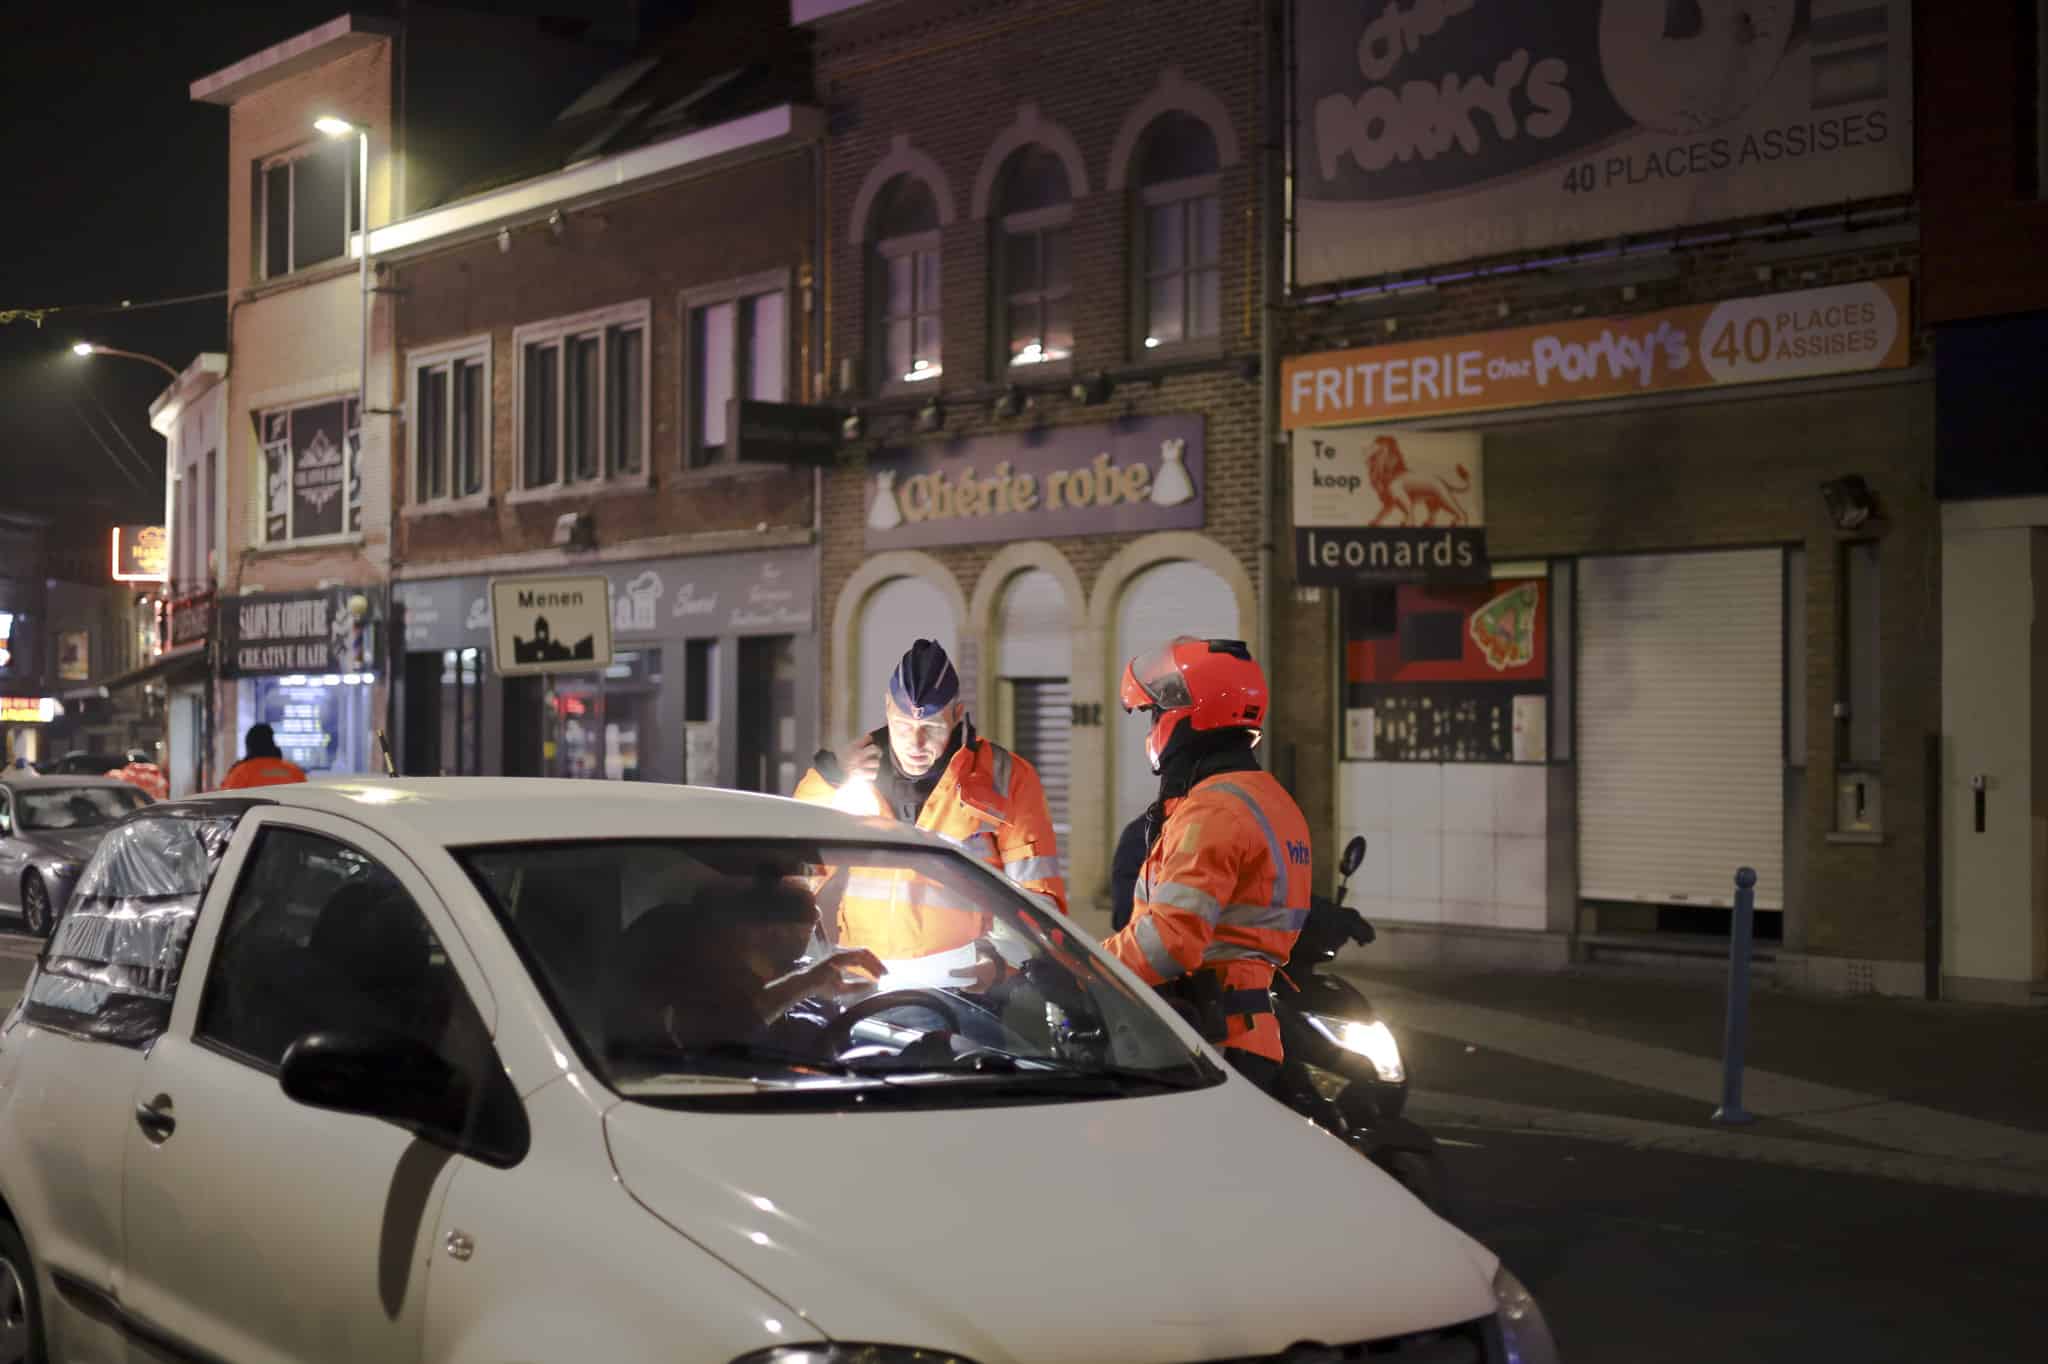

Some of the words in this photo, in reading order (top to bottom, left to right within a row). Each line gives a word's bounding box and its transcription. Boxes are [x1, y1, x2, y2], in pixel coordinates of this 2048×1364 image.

[1562, 163, 1596, 194] 40
[1605, 138, 1731, 188] PLACES
[1737, 110, 1890, 167] ASSISES
[1709, 317, 1773, 369] 40
[1776, 302, 1877, 333] PLACES
[1774, 328, 1879, 362] ASSISES
[1290, 350, 1484, 416] FRITERIE
[1531, 320, 1693, 387] Porky's
[1312, 439, 1337, 460] Te
[900, 459, 1039, 524] Chérie
[1045, 451, 1151, 511] robe
[1312, 467, 1362, 495] koop
[1308, 530, 1474, 568] leonards
[517, 588, 584, 609] Menen
